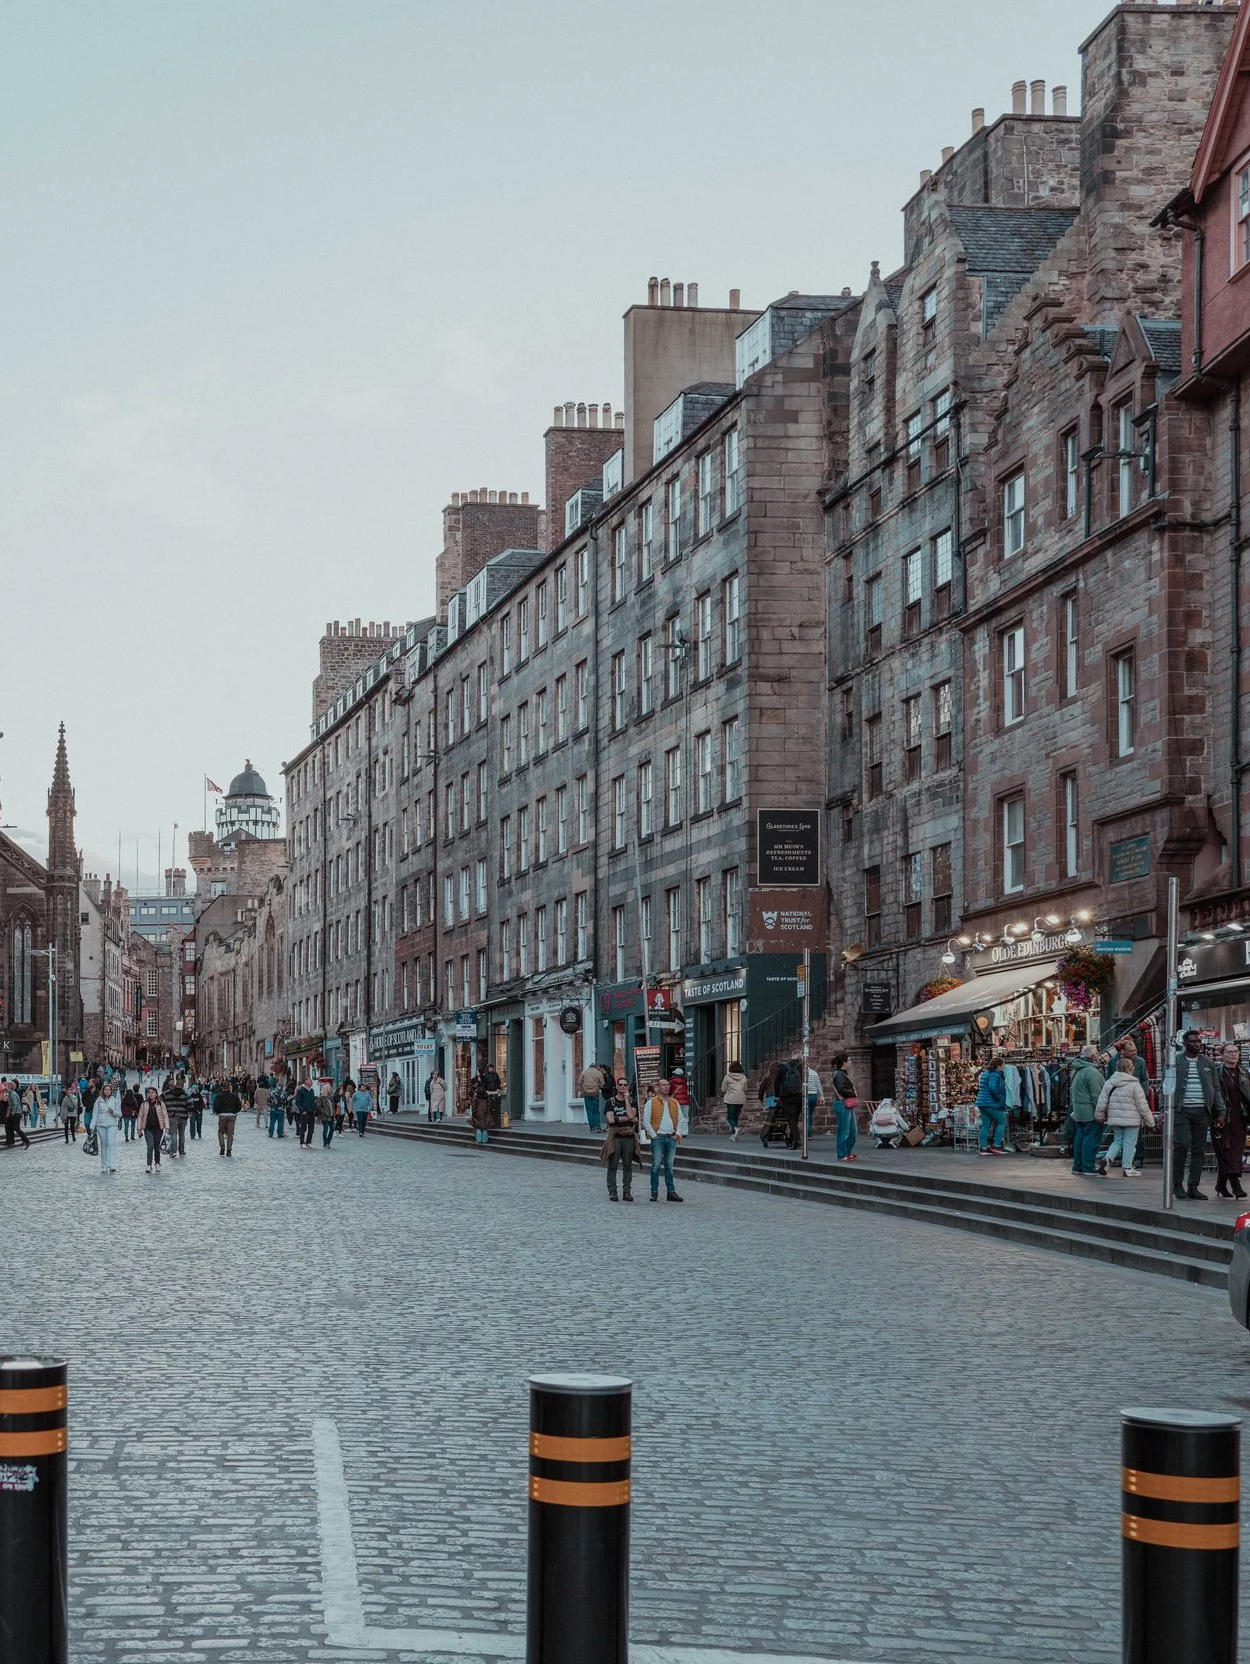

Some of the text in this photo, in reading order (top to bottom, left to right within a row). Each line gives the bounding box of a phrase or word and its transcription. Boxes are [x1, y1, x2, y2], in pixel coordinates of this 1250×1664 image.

[991, 944, 1017, 963] OLDE
[684, 978, 744, 998] TASTE OF SCOTLAND
[3, 1041, 10, 1049] K
[373, 1035, 387, 1049] HOUE
[393, 1028, 417, 1046] SCOTLAND
